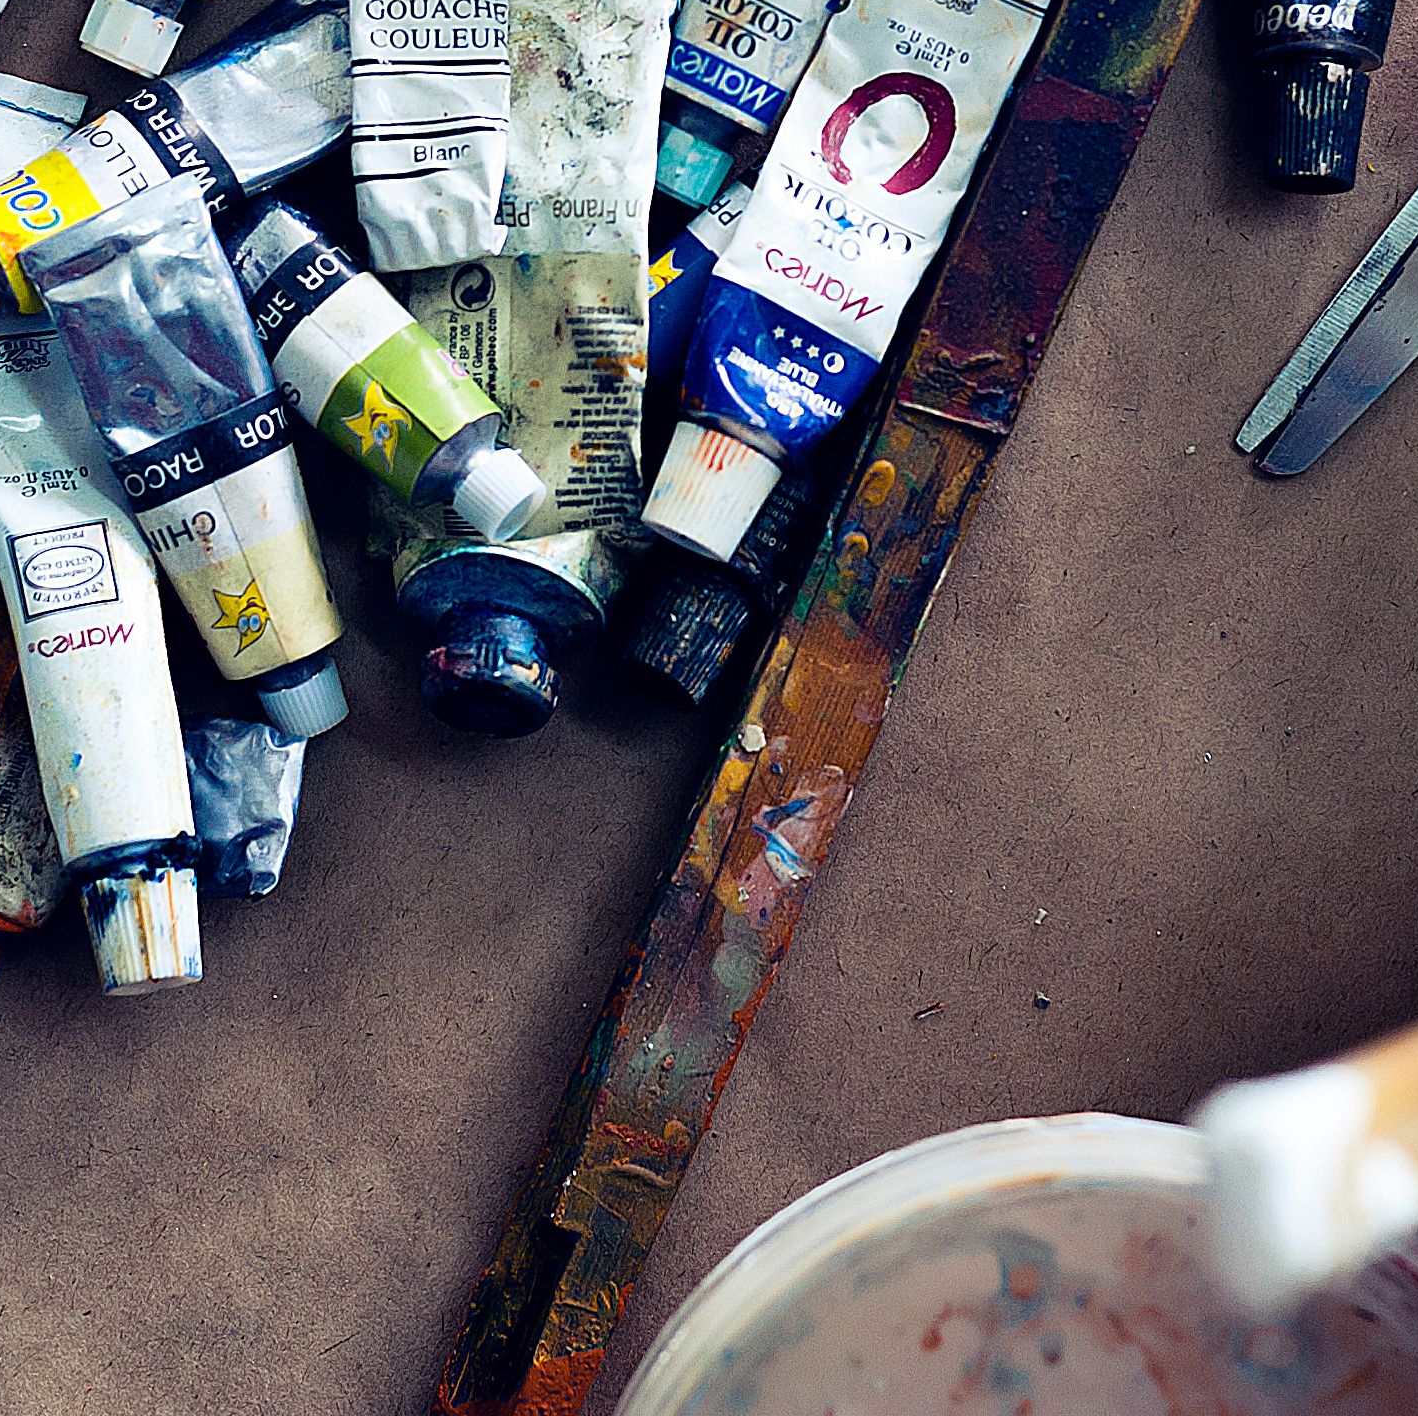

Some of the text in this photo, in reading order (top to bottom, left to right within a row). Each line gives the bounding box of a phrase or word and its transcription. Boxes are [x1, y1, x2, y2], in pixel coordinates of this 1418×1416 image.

[371, 27, 510, 49] COULEUR
[706, 13, 756, 58] OIL
[914, 48, 950, 71] 12ml
[672, 45, 778, 111] Marie's
[149, 109, 216, 194] WATER
[553, 199, 616, 224] France
[766, 249, 883, 320] Marie's
[447, 310, 460, 323] by
[461, 345, 469, 359] BP
[776, 357, 819, 387] BLUE
[235, 407, 284, 448] LOR
[41, 477, 79, 493] 12ml
[42, 463, 88, 482] 0.4US
[33, 578, 103, 602] APPROVED
[37, 624, 133, 657] Marie's
